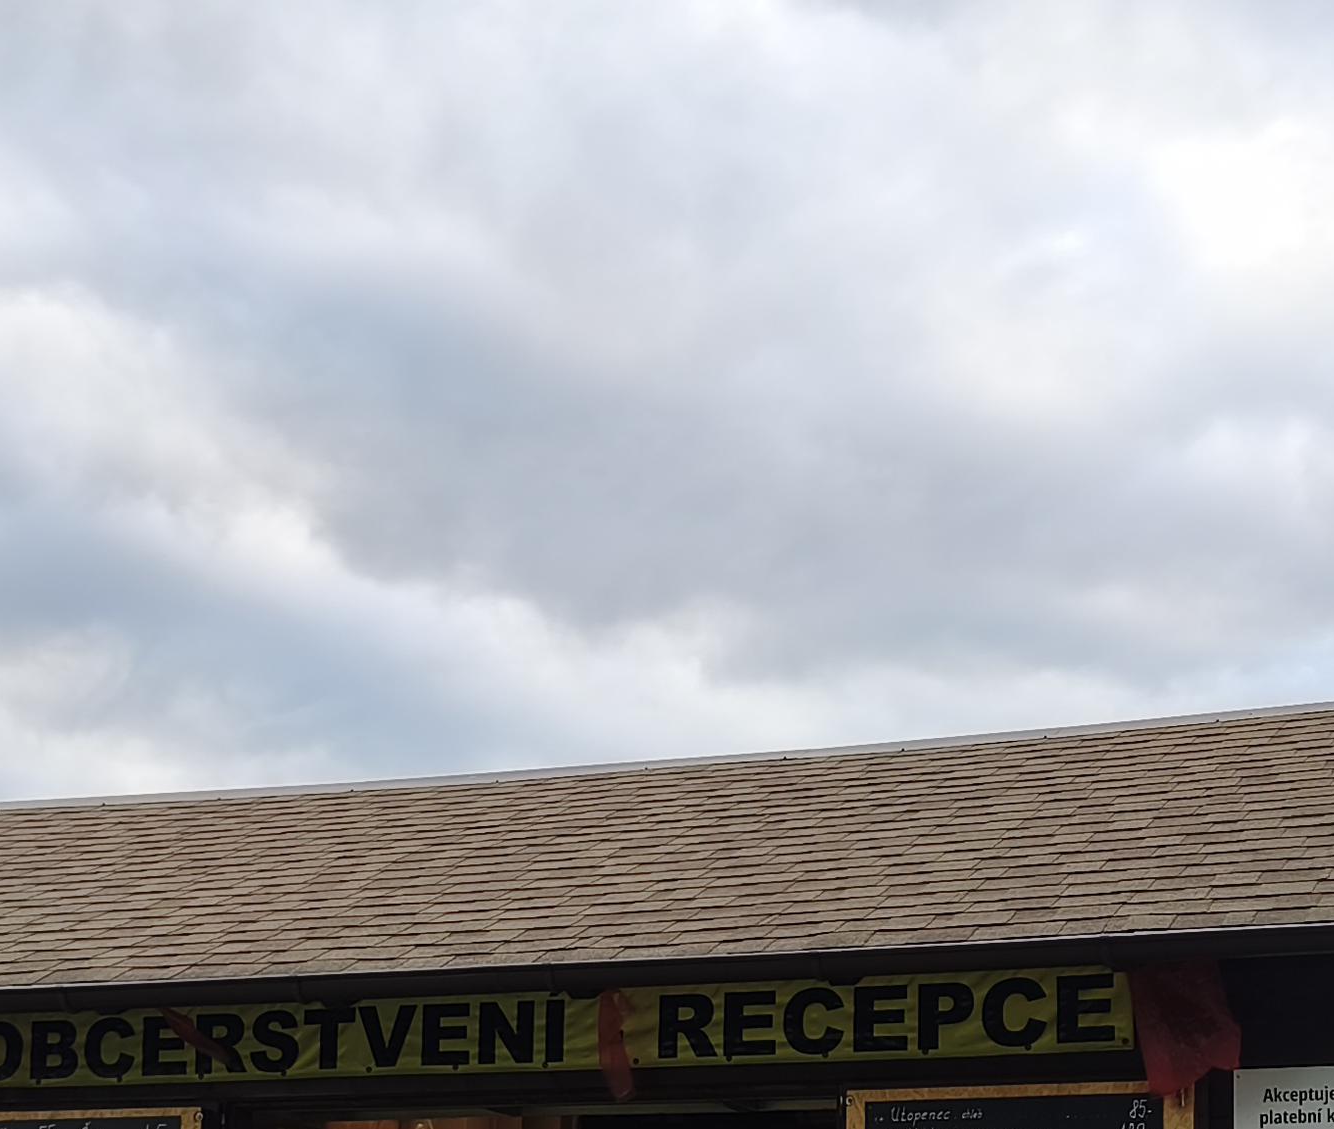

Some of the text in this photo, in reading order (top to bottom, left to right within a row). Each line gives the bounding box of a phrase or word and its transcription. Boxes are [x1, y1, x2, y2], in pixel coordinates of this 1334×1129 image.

[657, 973, 1117, 1059] RECEPCE
[890, 1106, 950, 1126] Utopenec
[1259, 1108, 1322, 1128] platební
